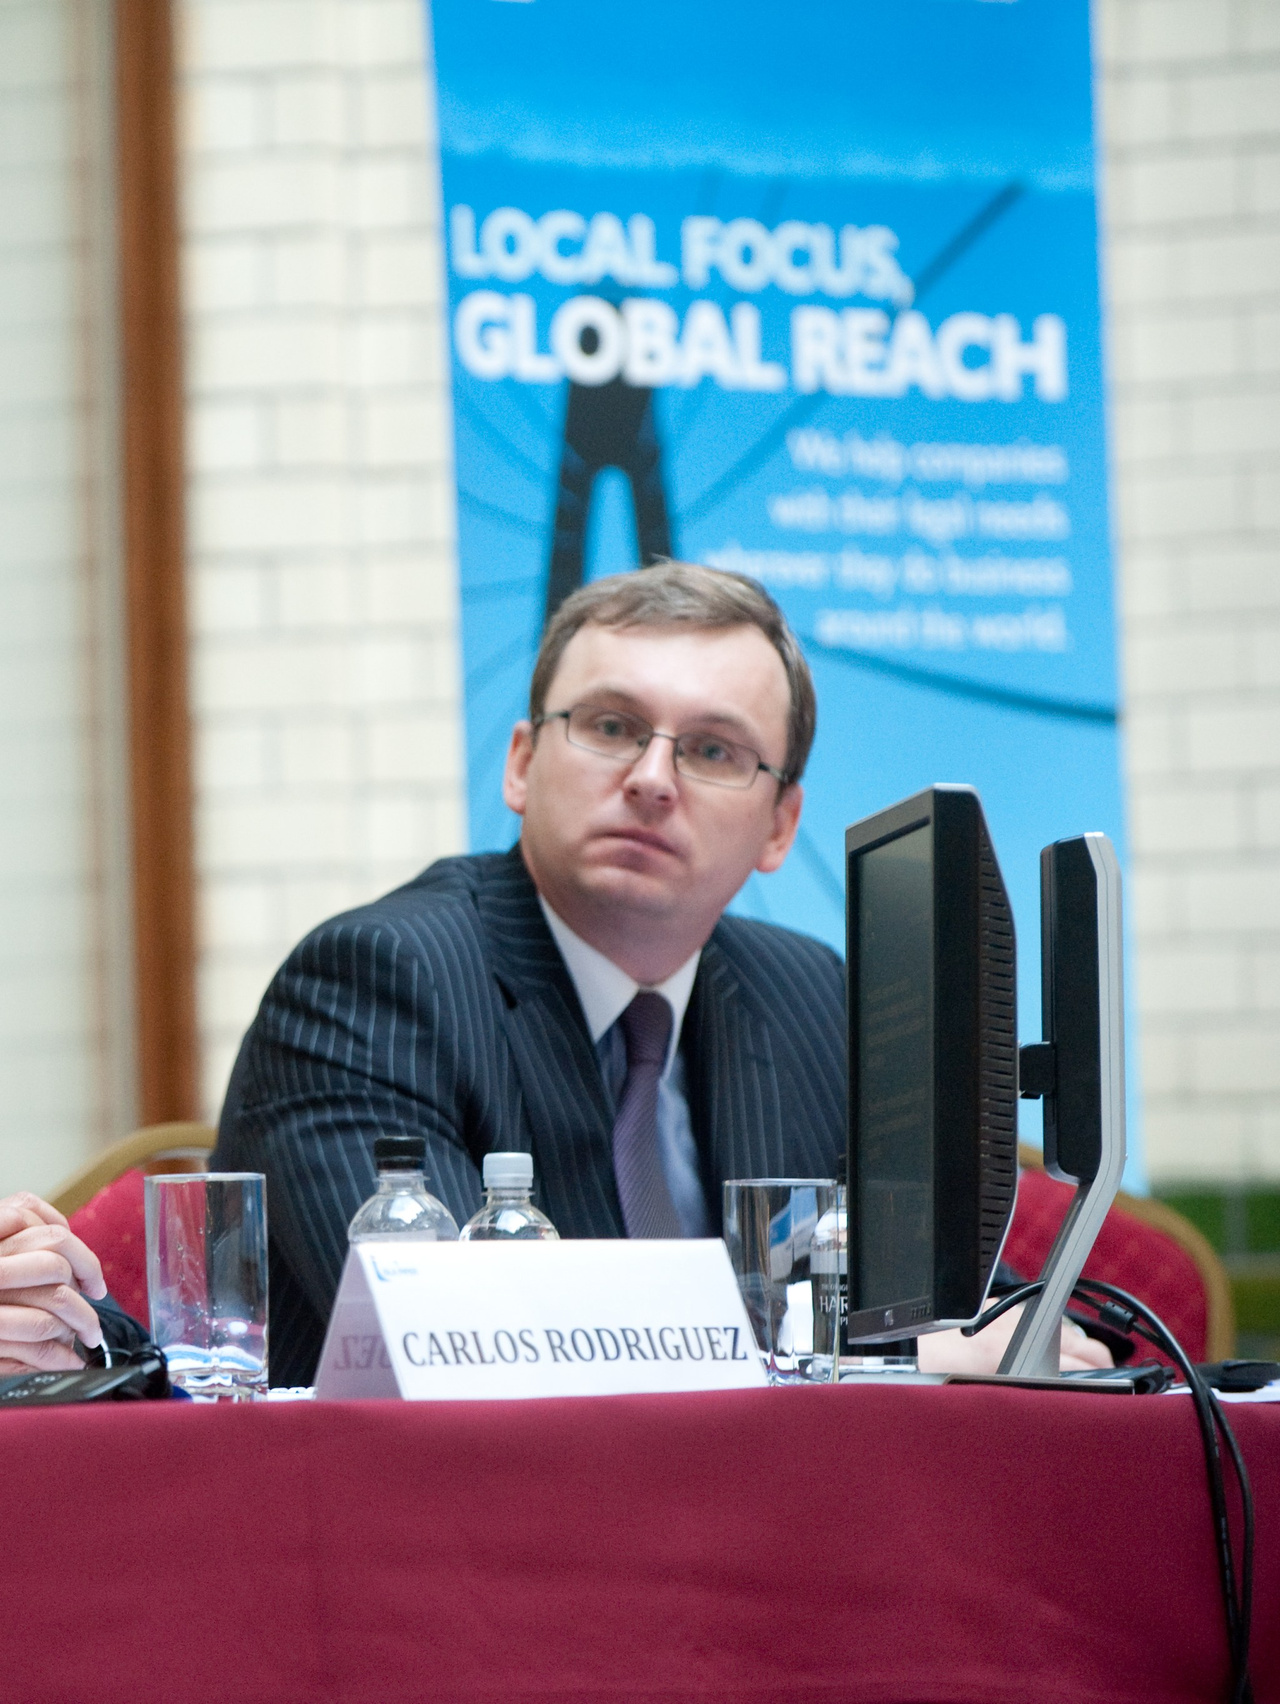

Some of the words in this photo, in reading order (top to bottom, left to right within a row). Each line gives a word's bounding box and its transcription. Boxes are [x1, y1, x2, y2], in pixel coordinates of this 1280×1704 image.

[449, 203, 677, 287] LOCAL
[682, 215, 915, 308] FOCUS,
[455, 290, 786, 390] GLOBAL
[791, 304, 1068, 401] REACH
[402, 1329, 540, 1367] CARLOS
[544, 1327, 749, 1361] RODRIGUEZ
